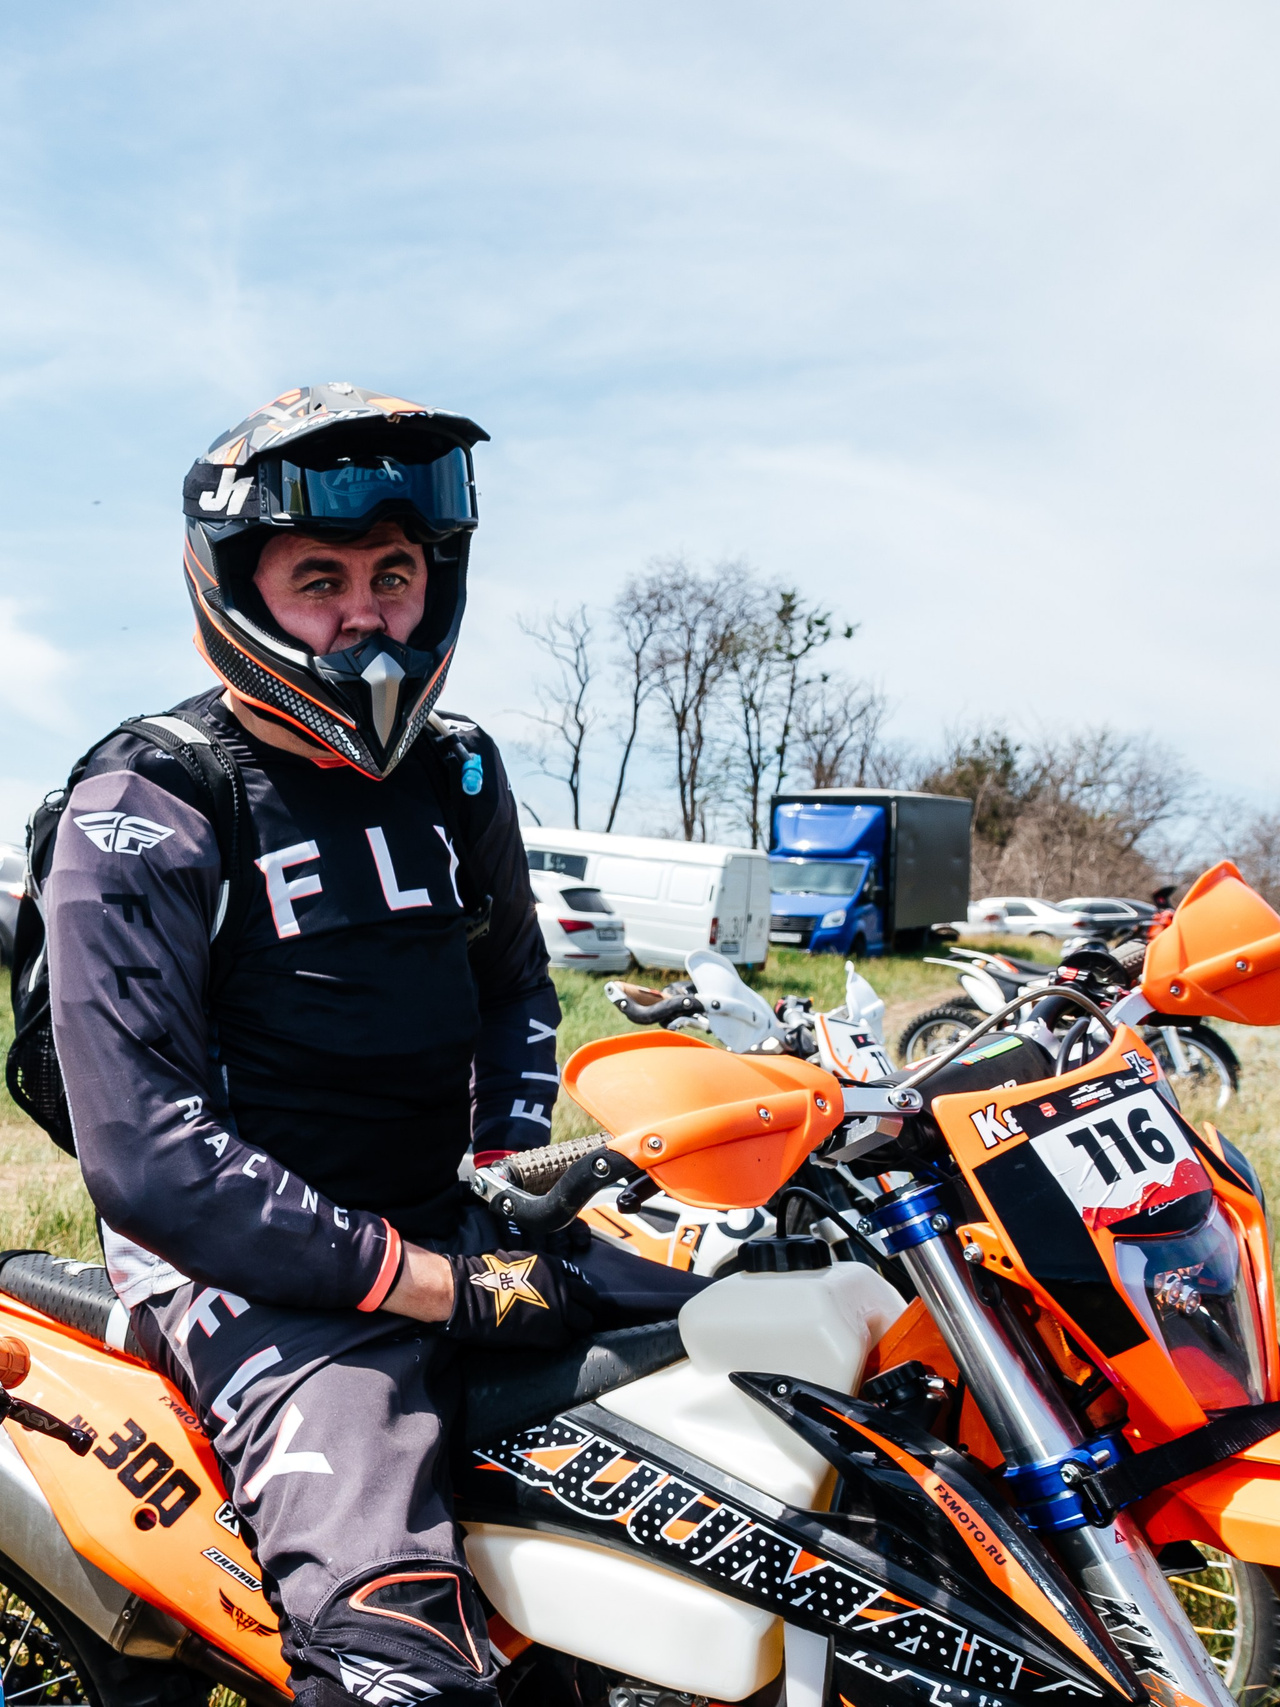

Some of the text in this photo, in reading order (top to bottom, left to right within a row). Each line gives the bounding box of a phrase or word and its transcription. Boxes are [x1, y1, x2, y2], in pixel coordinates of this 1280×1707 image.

[332, 460, 404, 487] Airoh
[510, 1018, 560, 1128] FLY
[176, 1095, 350, 1231] RACING
[1065, 1107, 1176, 1187] 116
[14, 1408, 61, 1431] ASV
[174, 1286, 335, 1503] FLY
[92, 1417, 202, 1528] 300
[933, 1483, 1008, 1567] FXMOTO.RU
[206, 1548, 262, 1589] ZUUMAV
